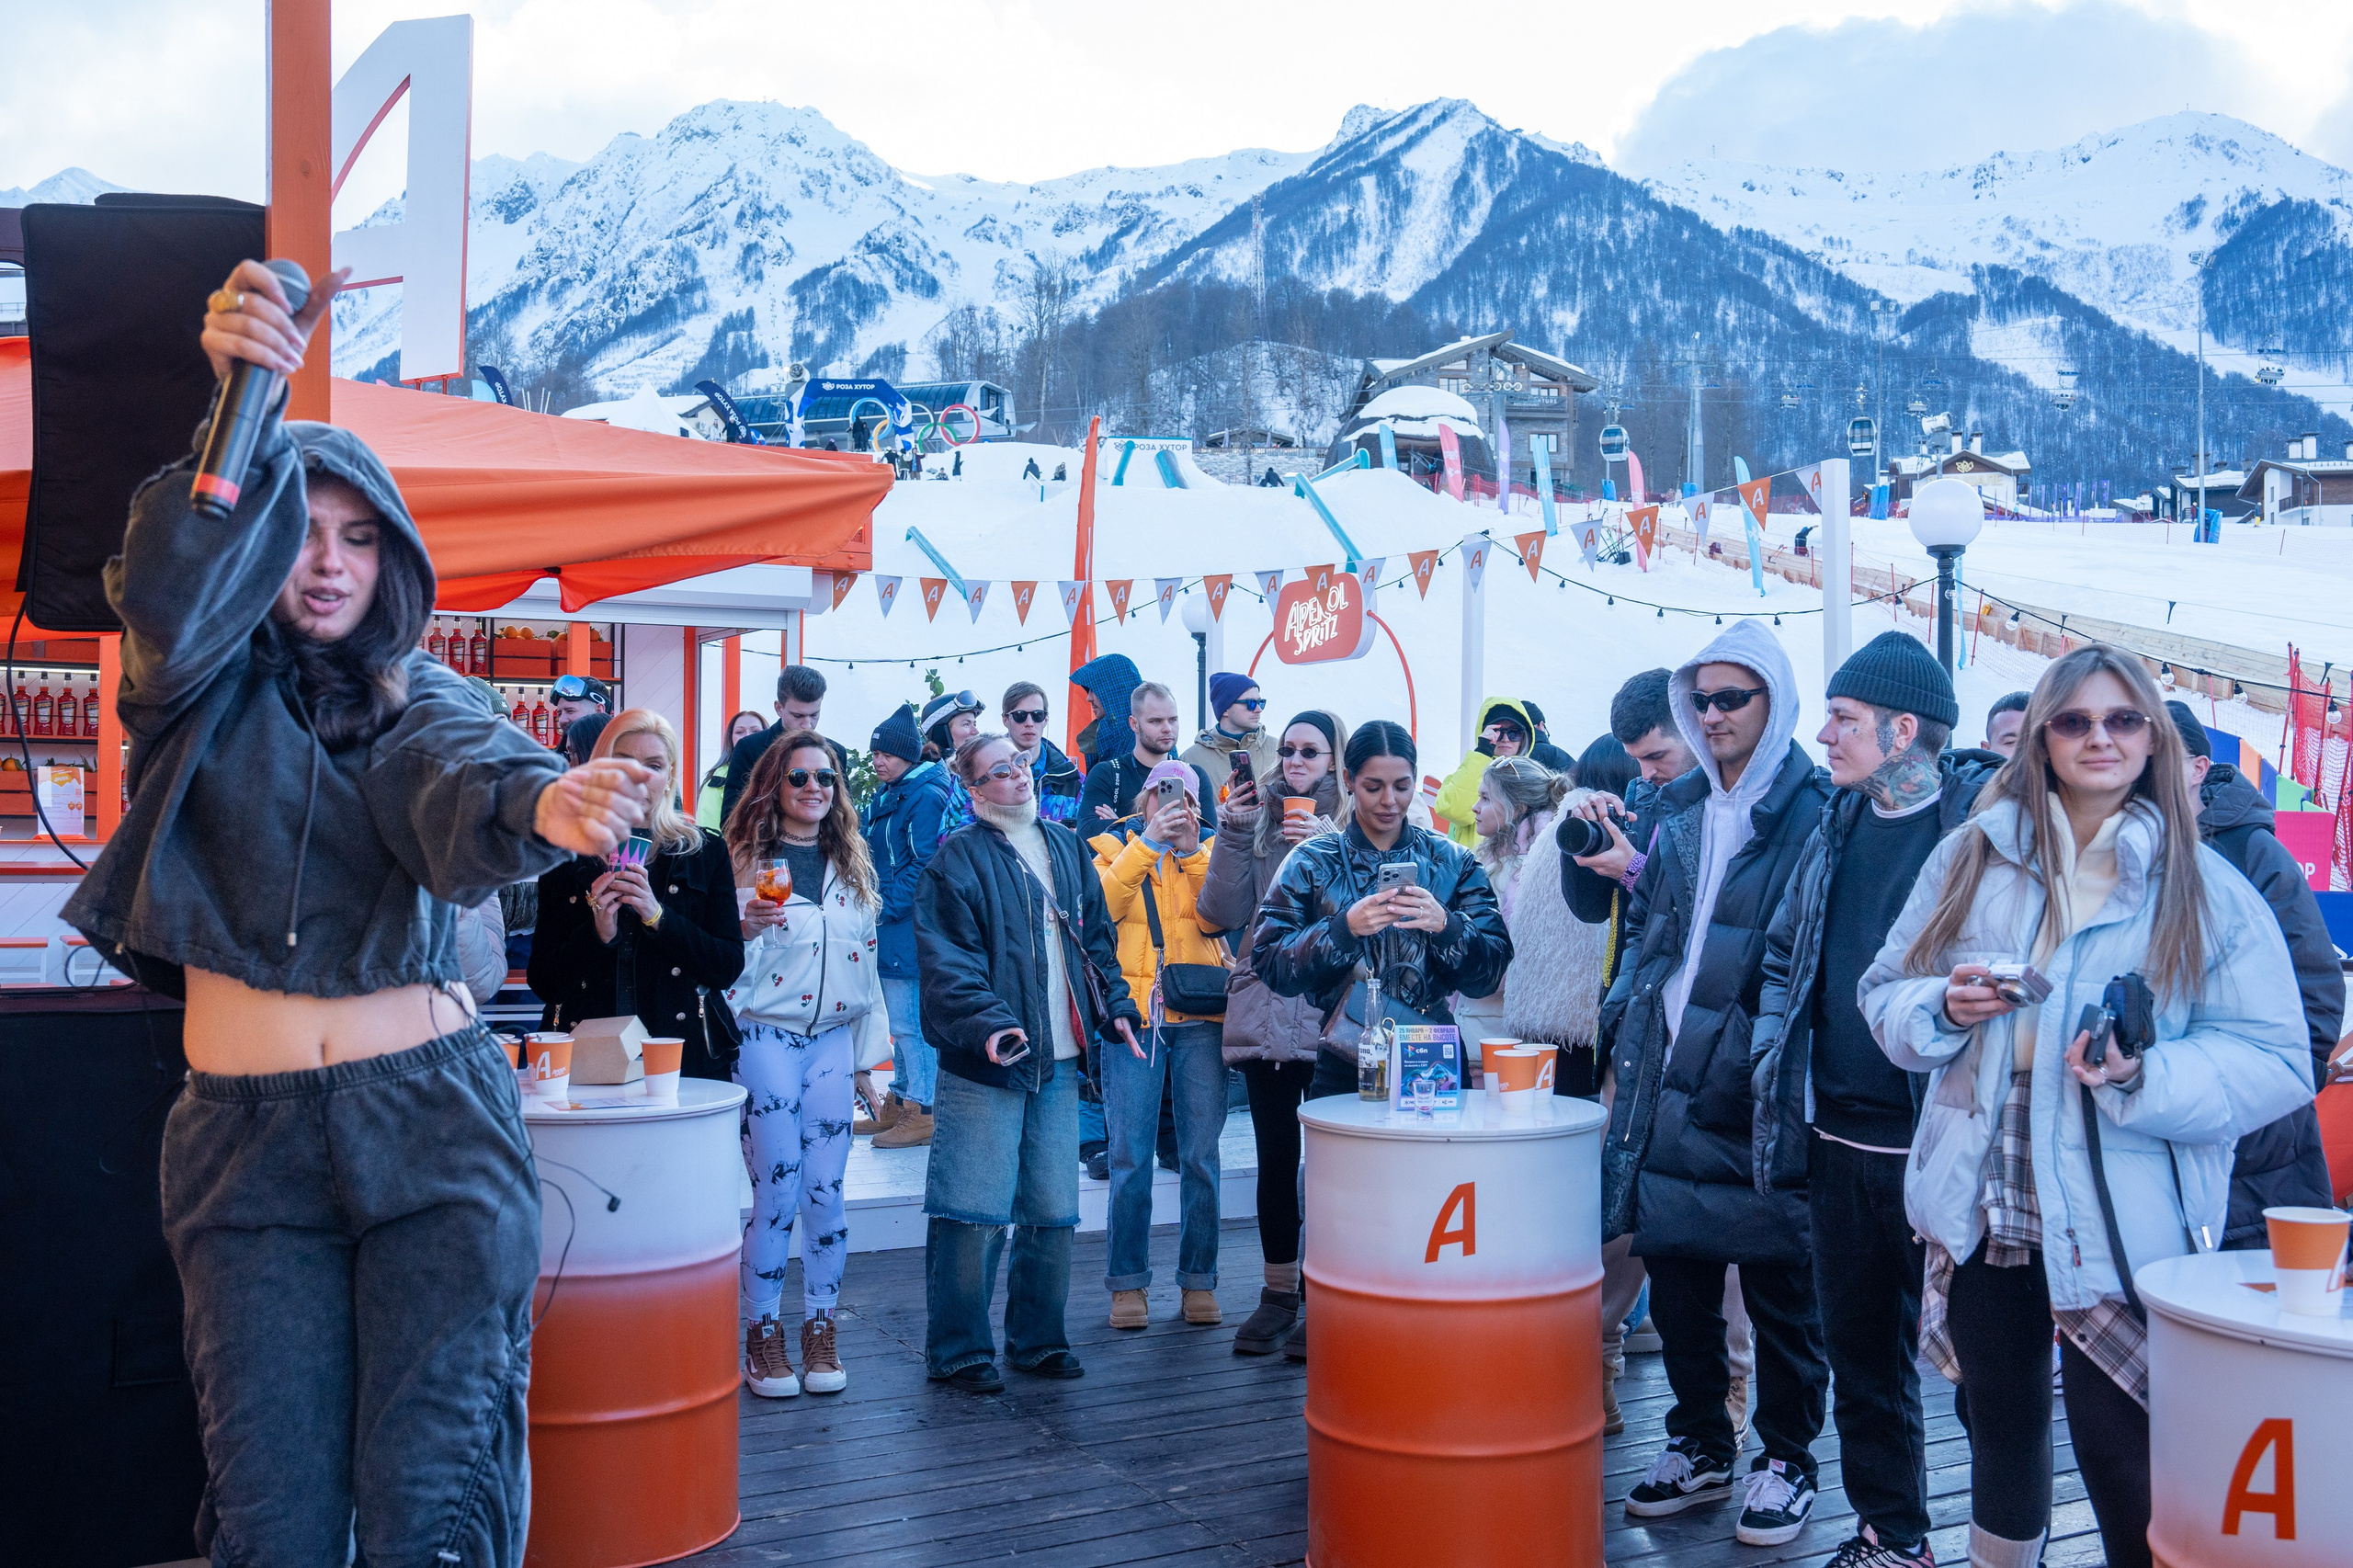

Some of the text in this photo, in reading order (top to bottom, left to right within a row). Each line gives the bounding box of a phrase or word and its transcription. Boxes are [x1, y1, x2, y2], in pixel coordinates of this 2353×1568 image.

[1811, 471, 1822, 493] A
[1752, 487, 1765, 509] A
[1695, 501, 1707, 521] A
[1639, 515, 1652, 537] A
[1584, 528, 1596, 549] A
[1470, 550, 1482, 569] A
[1526, 540, 1539, 560] A
[1363, 565, 1375, 584] A
[1417, 558, 1429, 577] A
[835, 576, 849, 592] A
[881, 583, 893, 598] A
[1211, 582, 1223, 600] A
[1267, 574, 1278, 594] A
[1316, 572, 1328, 592] A
[926, 585, 938, 602] A
[971, 586, 982, 604] A
[1018, 587, 1029, 605] A
[1066, 587, 1076, 605] A
[1115, 585, 1126, 605] A
[1161, 585, 1173, 602] A
[536, 1051, 551, 1081] A
[1536, 1057, 1554, 1090] A
[1424, 1181, 1476, 1264] A
[2222, 1417, 2297, 1540] A
